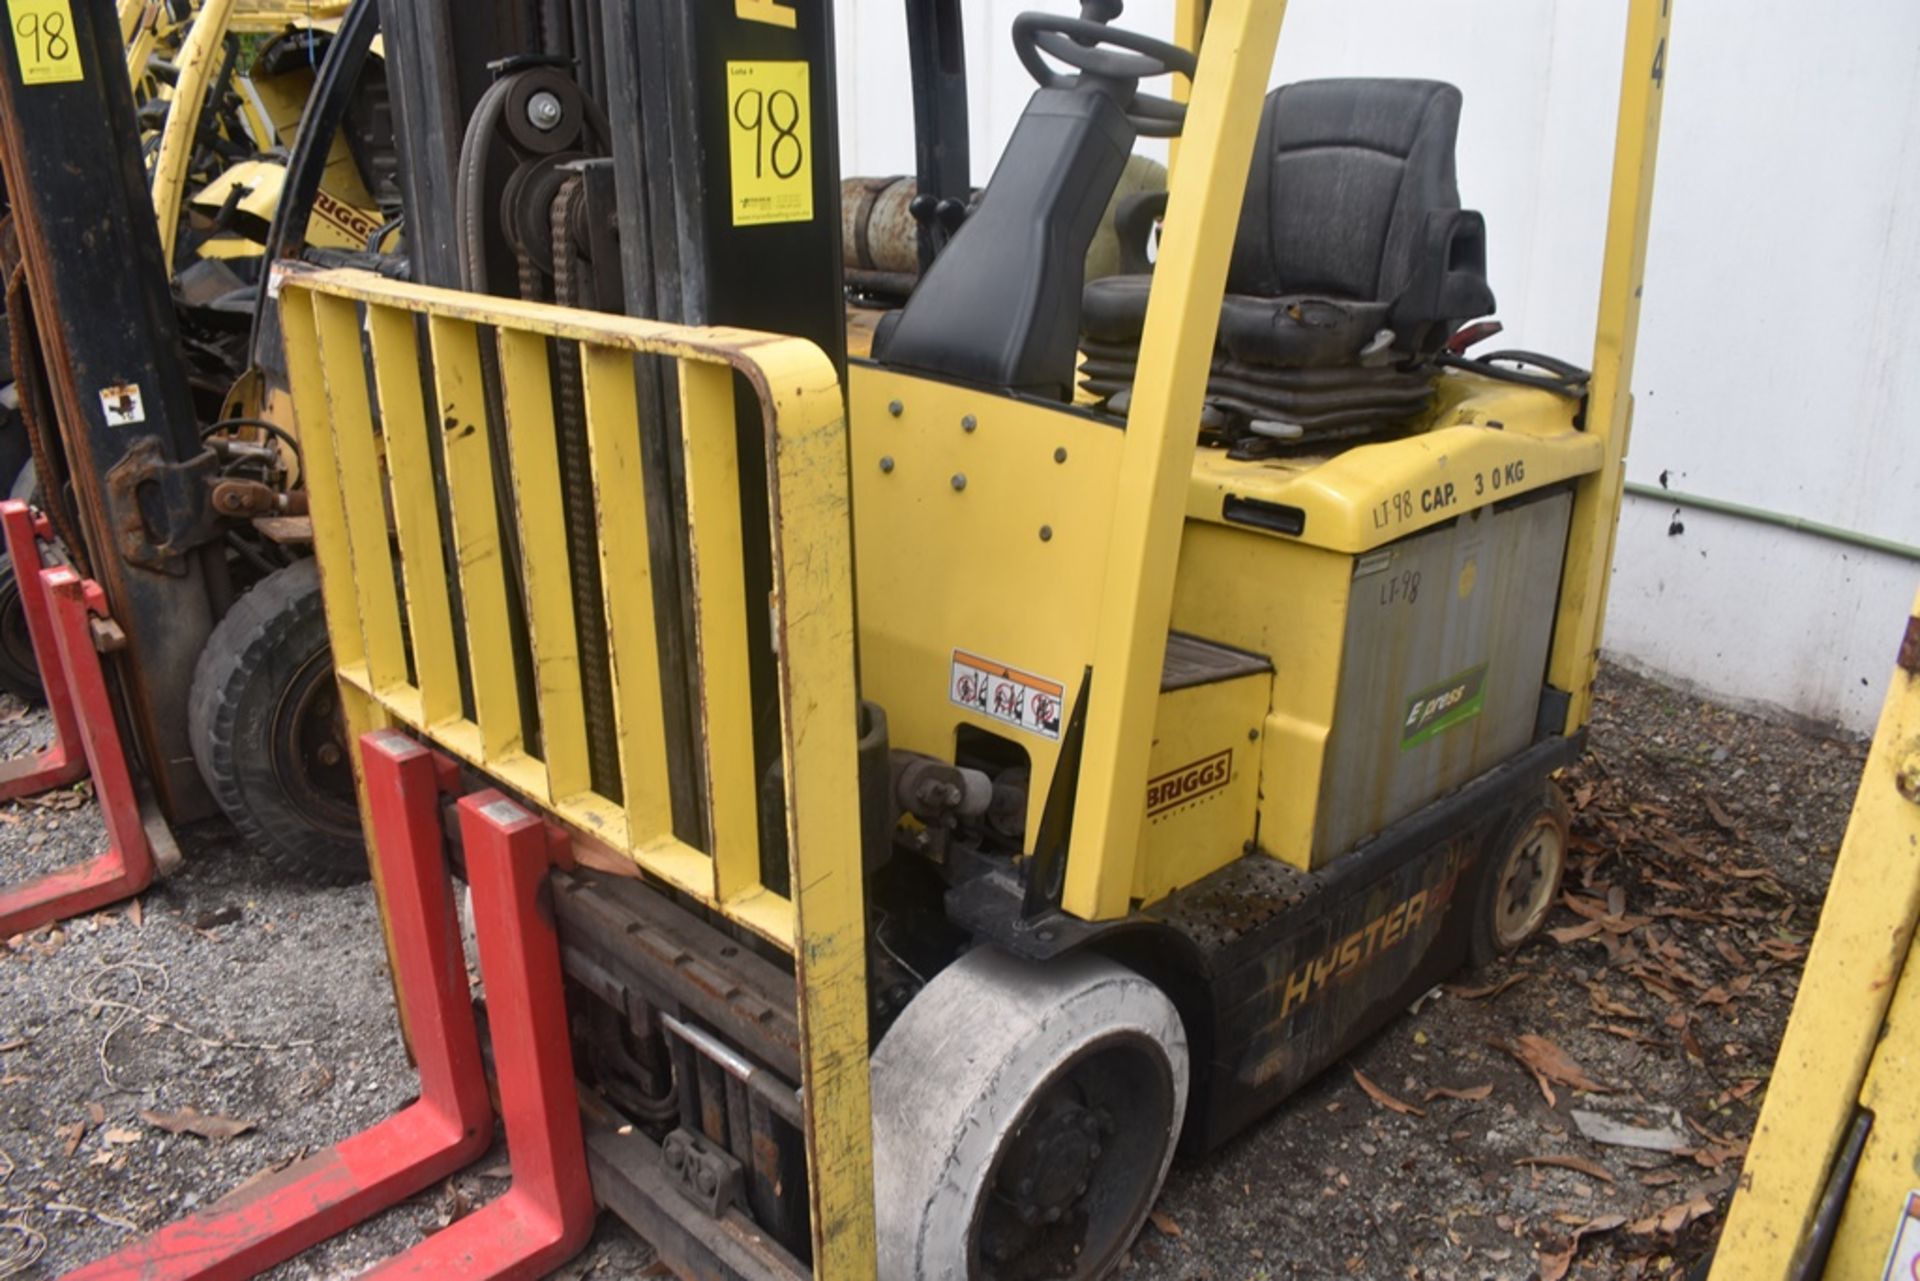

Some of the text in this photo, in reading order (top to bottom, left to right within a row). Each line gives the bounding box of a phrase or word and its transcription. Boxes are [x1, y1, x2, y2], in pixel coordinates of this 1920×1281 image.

[16, 11, 69, 63] 98
[734, 88, 802, 179] 98
[315, 191, 377, 240] RIGG
[1420, 482, 1457, 514] CAP.
[1380, 568, 1421, 605] LT-98
[1147, 759, 1226, 809] BRIGGS
[1280, 889, 1429, 1019] HYSTER
